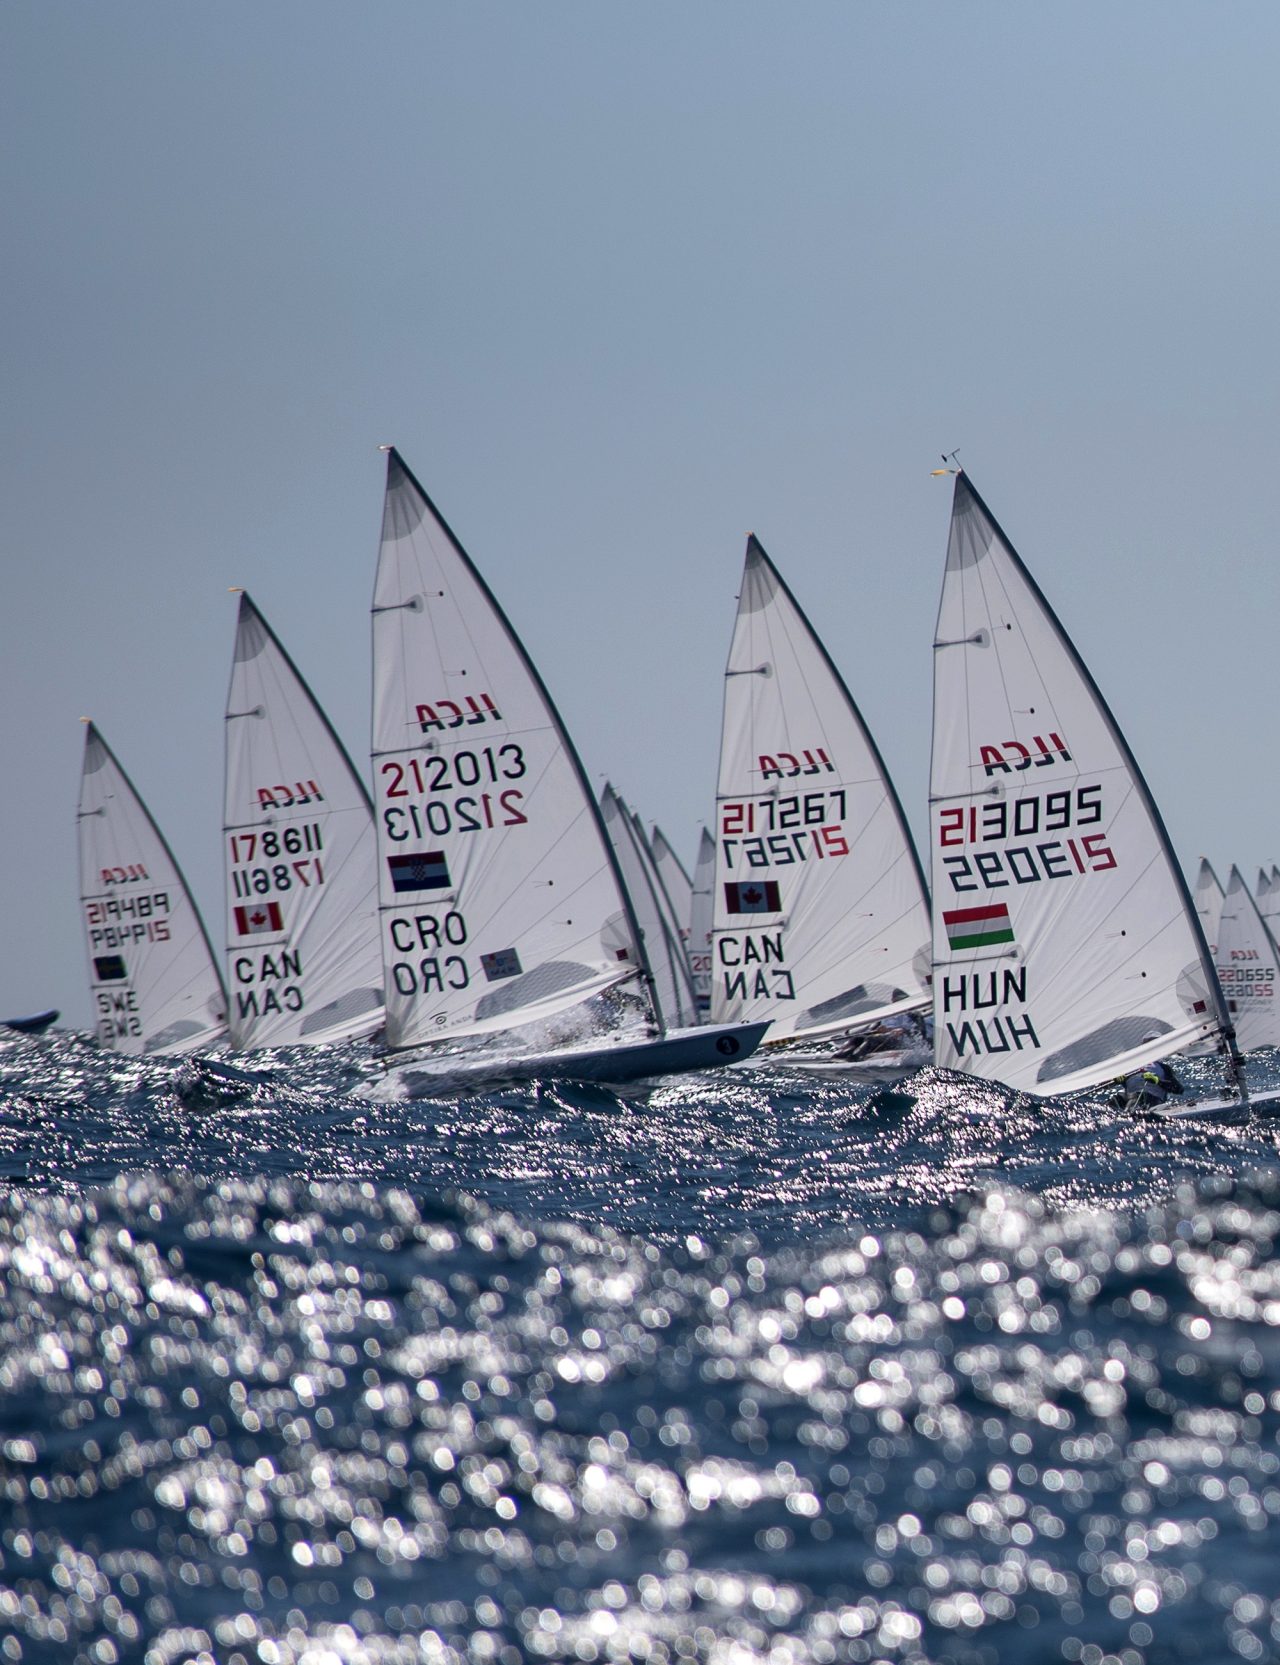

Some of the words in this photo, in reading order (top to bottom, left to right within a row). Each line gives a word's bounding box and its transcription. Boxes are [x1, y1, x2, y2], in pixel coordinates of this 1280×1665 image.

[382, 744, 526, 798] 212013
[723, 790, 846, 835] 217267
[940, 784, 1101, 847] 213095
[231, 823, 323, 863] 178611
[86, 892, 170, 925] 219489
[391, 911, 467, 952] CRO
[719, 933, 784, 966] CAN
[235, 949, 302, 984] CAN
[97, 991, 139, 1013] SWE
[943, 966, 1026, 1012] HUN
